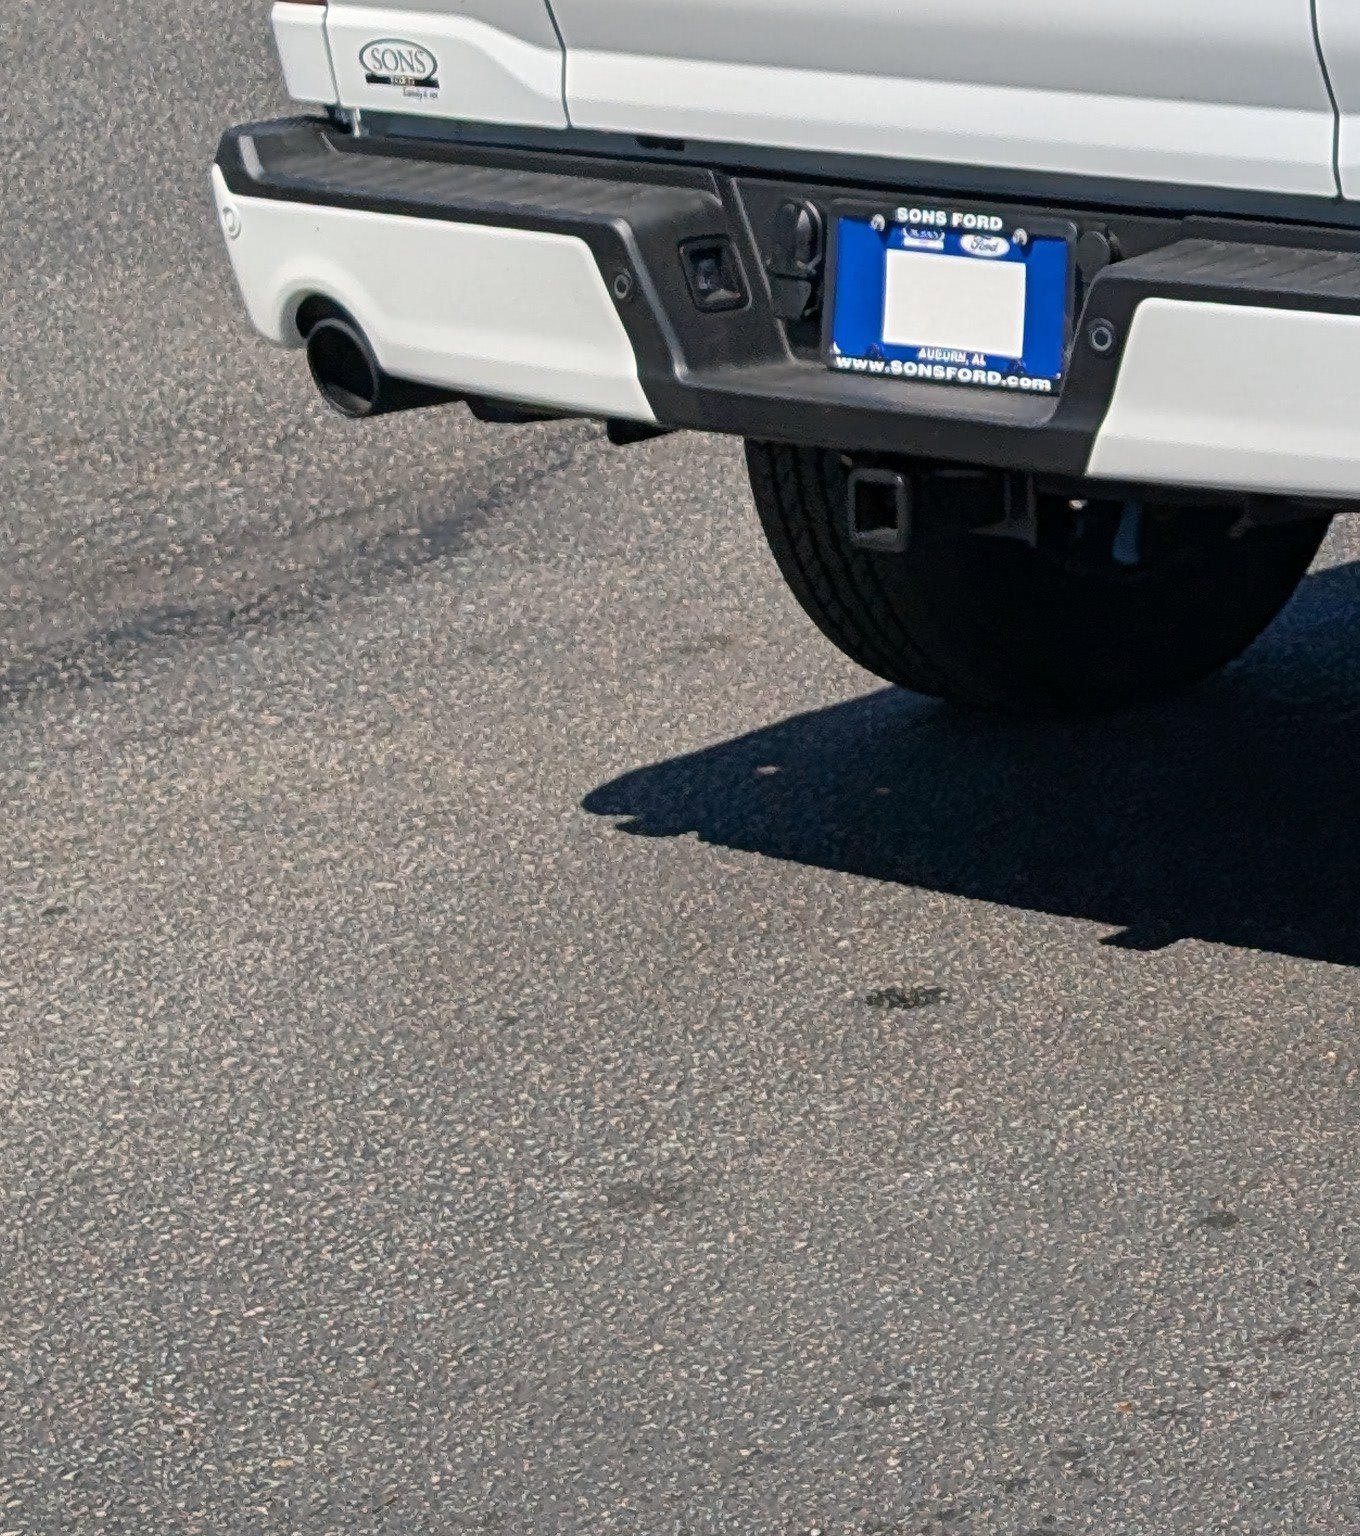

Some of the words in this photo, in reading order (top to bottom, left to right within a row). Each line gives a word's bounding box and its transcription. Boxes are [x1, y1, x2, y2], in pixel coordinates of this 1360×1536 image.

[370, 46, 427, 74] SONS
[896, 207, 948, 227] SONS
[951, 212, 1003, 232] FORD
[835, 355, 1053, 393] www.SONSFORD.com
